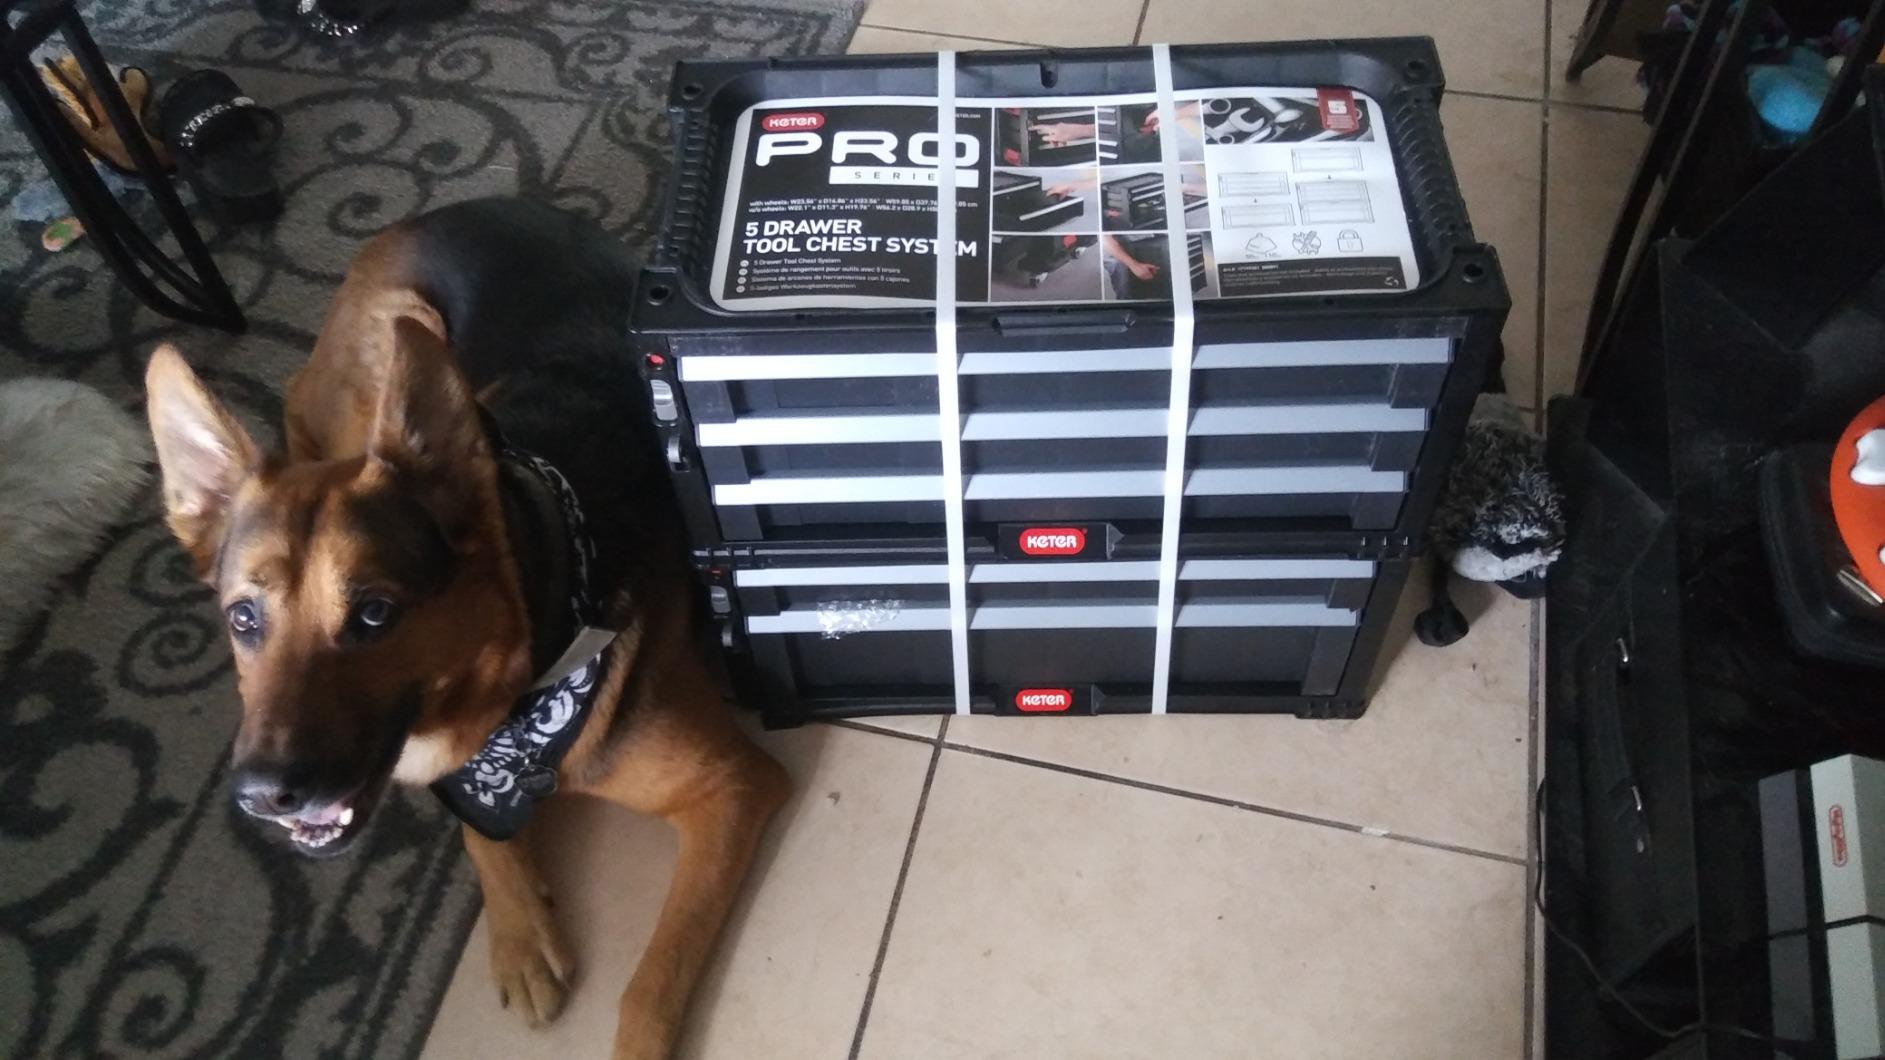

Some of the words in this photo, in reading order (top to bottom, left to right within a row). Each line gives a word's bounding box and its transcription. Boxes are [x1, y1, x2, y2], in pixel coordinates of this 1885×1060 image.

[769, 117, 817, 128] KETER
[755, 131, 980, 167] PRO
[854, 171, 936, 182] SERIE
[745, 221, 759, 237] 5
[763, 219, 863, 236] DRAWER
[743, 237, 801, 254] TOOL
[805, 236, 882, 253] CHEST
[886, 237, 977, 257] SYSTM
[1027, 535, 1077, 549] KETER
[1021, 694, 1065, 706] KETER
